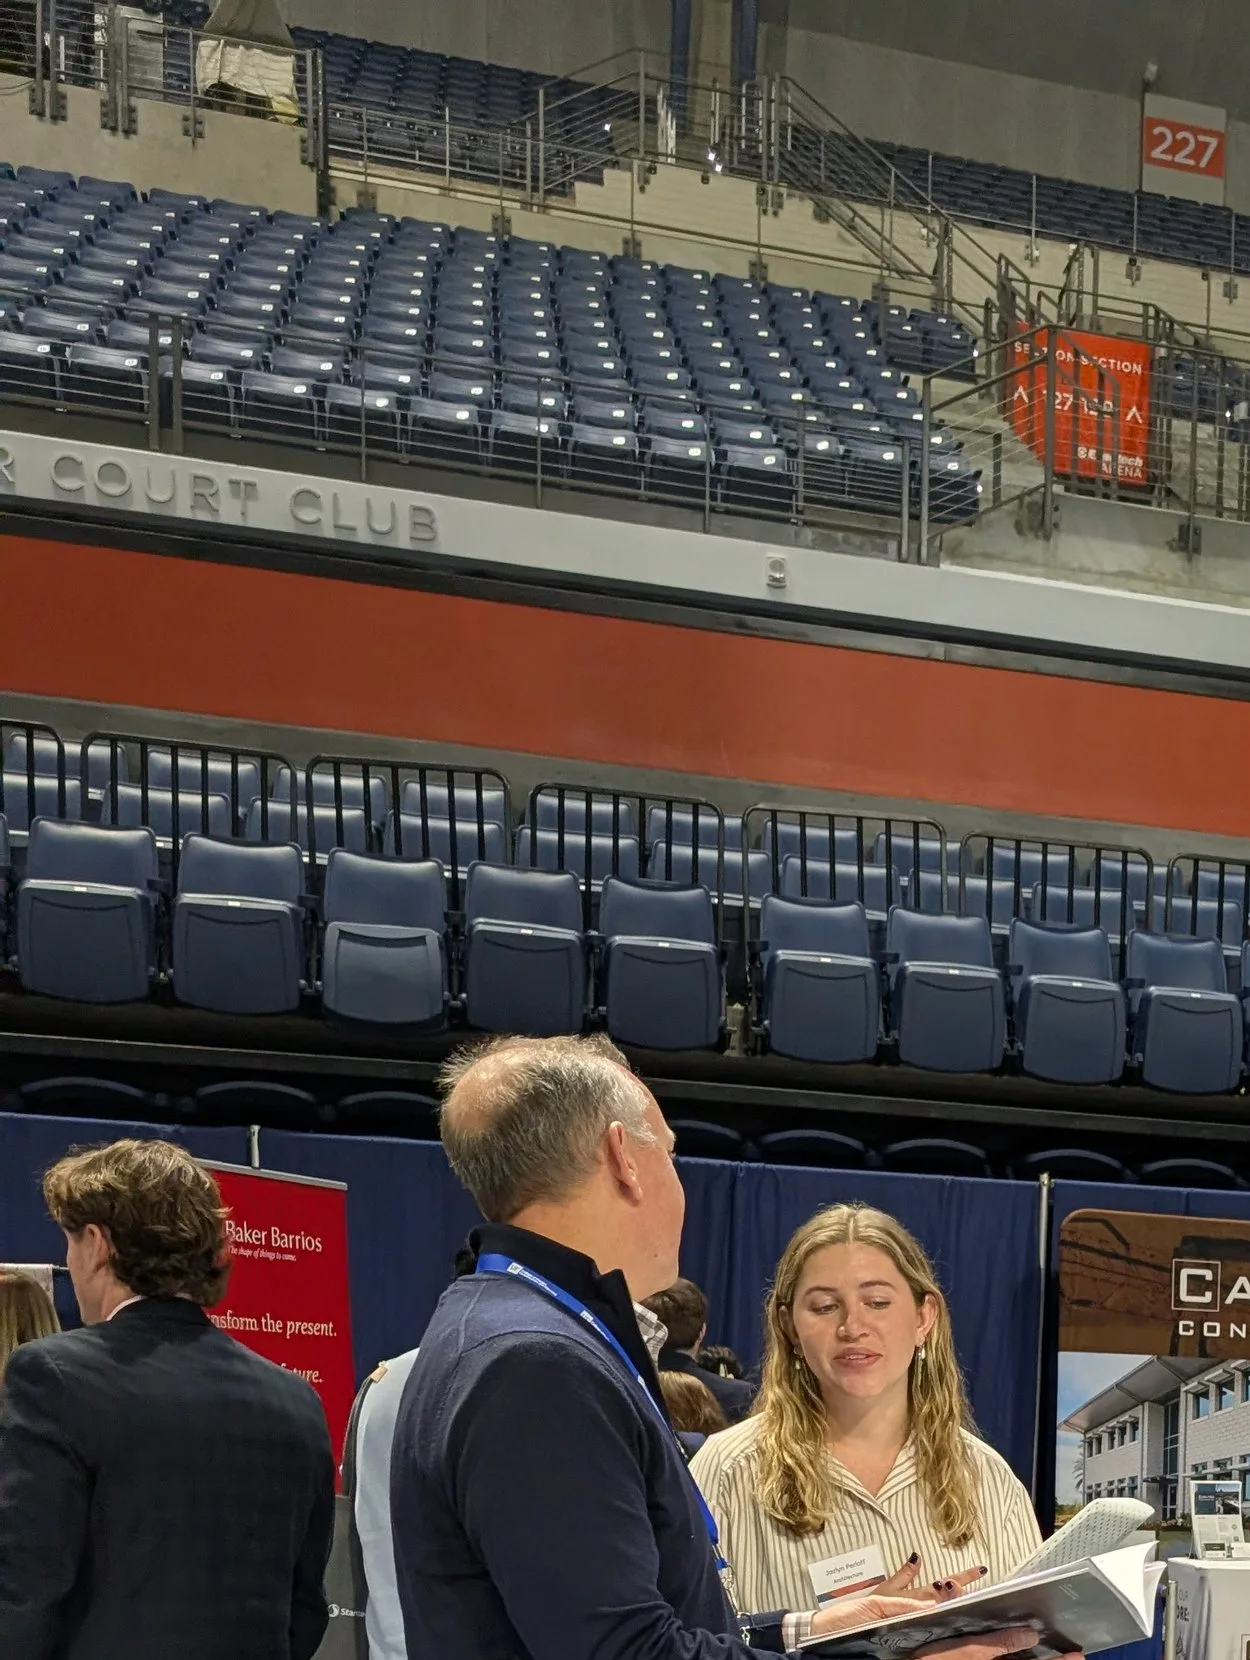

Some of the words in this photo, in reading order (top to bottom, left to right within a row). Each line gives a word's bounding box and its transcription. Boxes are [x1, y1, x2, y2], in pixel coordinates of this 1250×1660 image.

[1151, 126, 1219, 168] 227
[1080, 355, 1142, 375] SCTION
[1042, 390, 1074, 411] 27
[50, 452, 257, 516] COURT
[290, 488, 438, 543] CLUB
[225, 1220, 267, 1245] Baker
[271, 1226, 322, 1252] Barrios
[253, 1248, 260, 1259] of
[207, 1310, 259, 1331] nsform
[261, 1313, 283, 1333] the
[287, 1321, 337, 1338] present.
